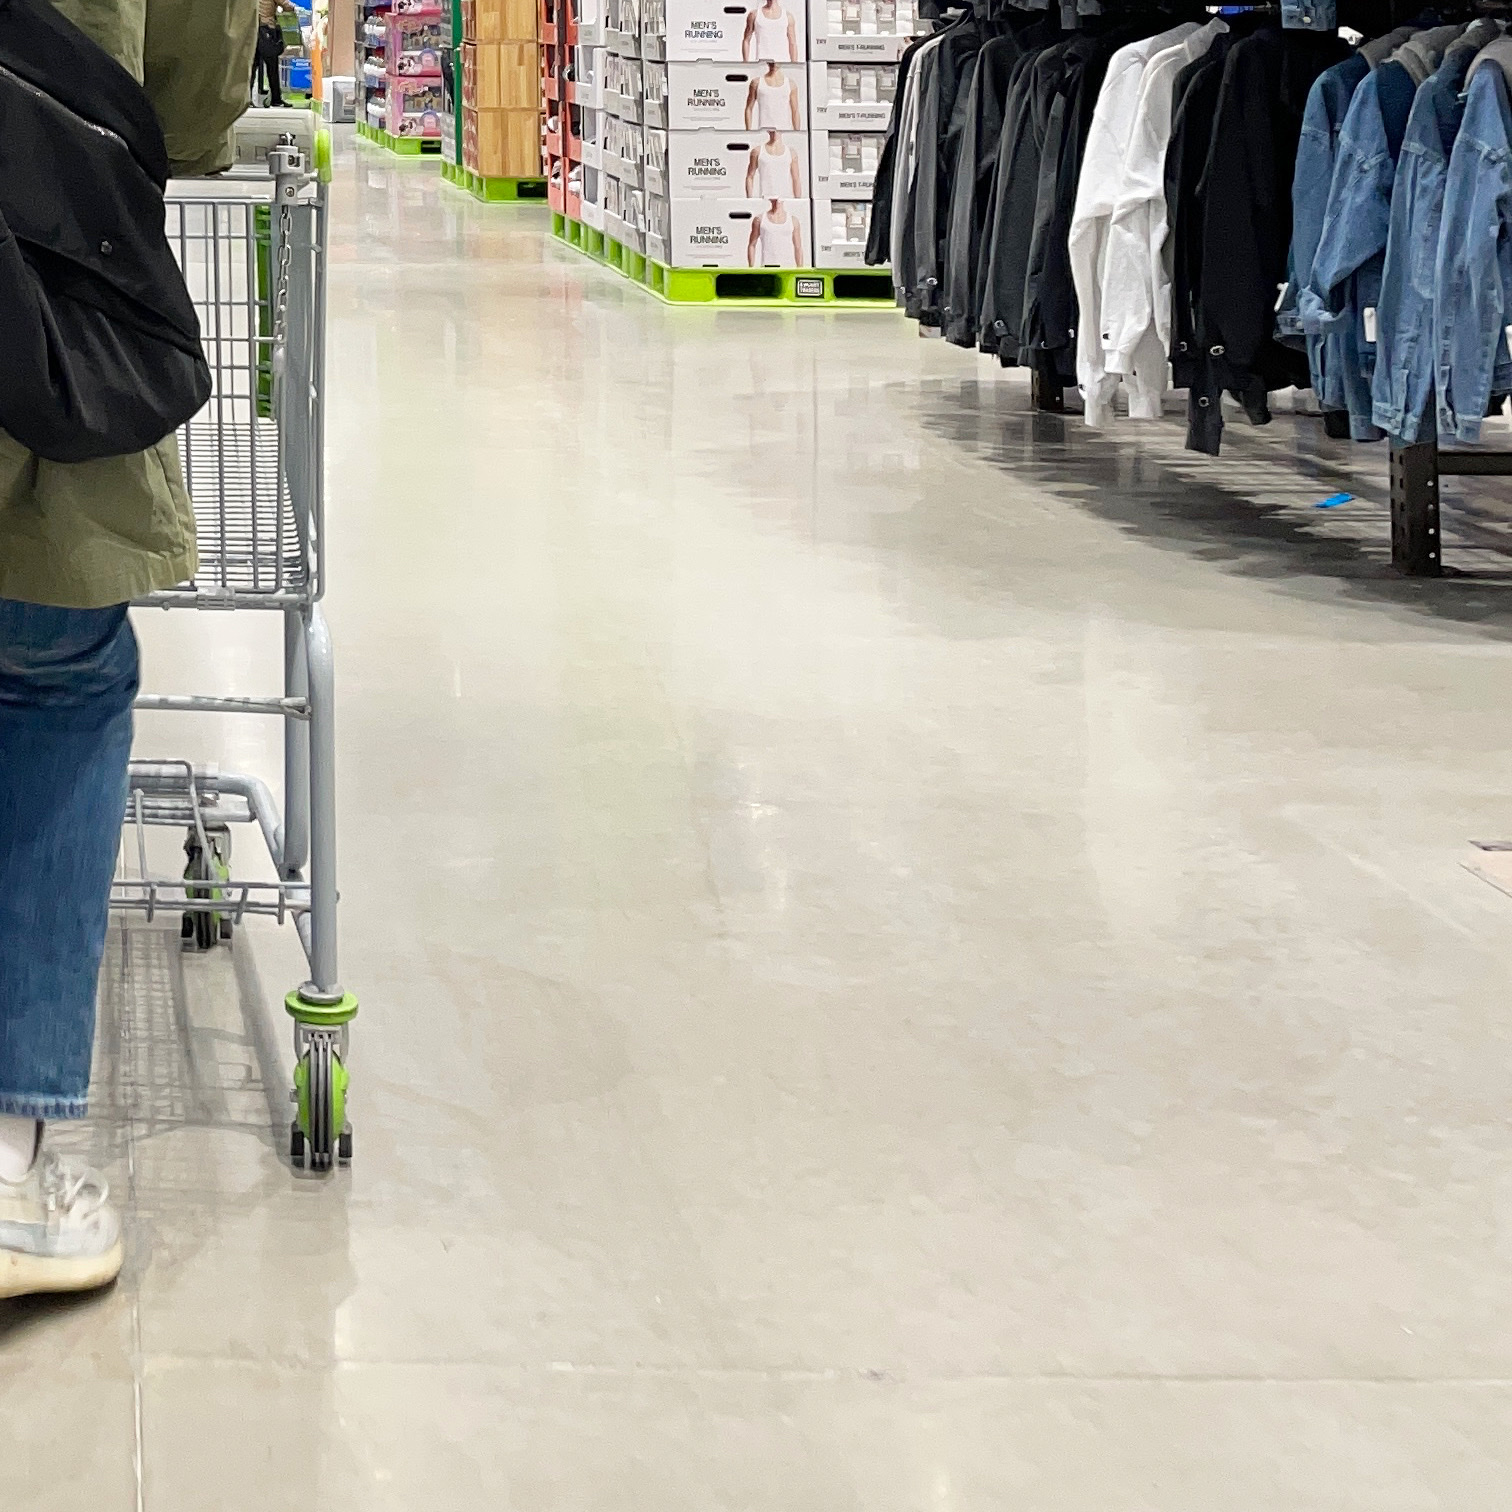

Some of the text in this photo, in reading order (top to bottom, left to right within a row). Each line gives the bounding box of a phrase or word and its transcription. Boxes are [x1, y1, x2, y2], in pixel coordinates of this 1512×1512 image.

[690, 21, 717, 29] MEN'S
[684, 30, 723, 39] RUNNING
[693, 89, 720, 98] MEN'S
[687, 98, 726, 107] RUNNING
[694, 158, 721, 167] MEN'S
[688, 167, 727, 176] RUNNING
[696, 226, 723, 235] MEN'S
[690, 236, 729, 244] RUNNING
